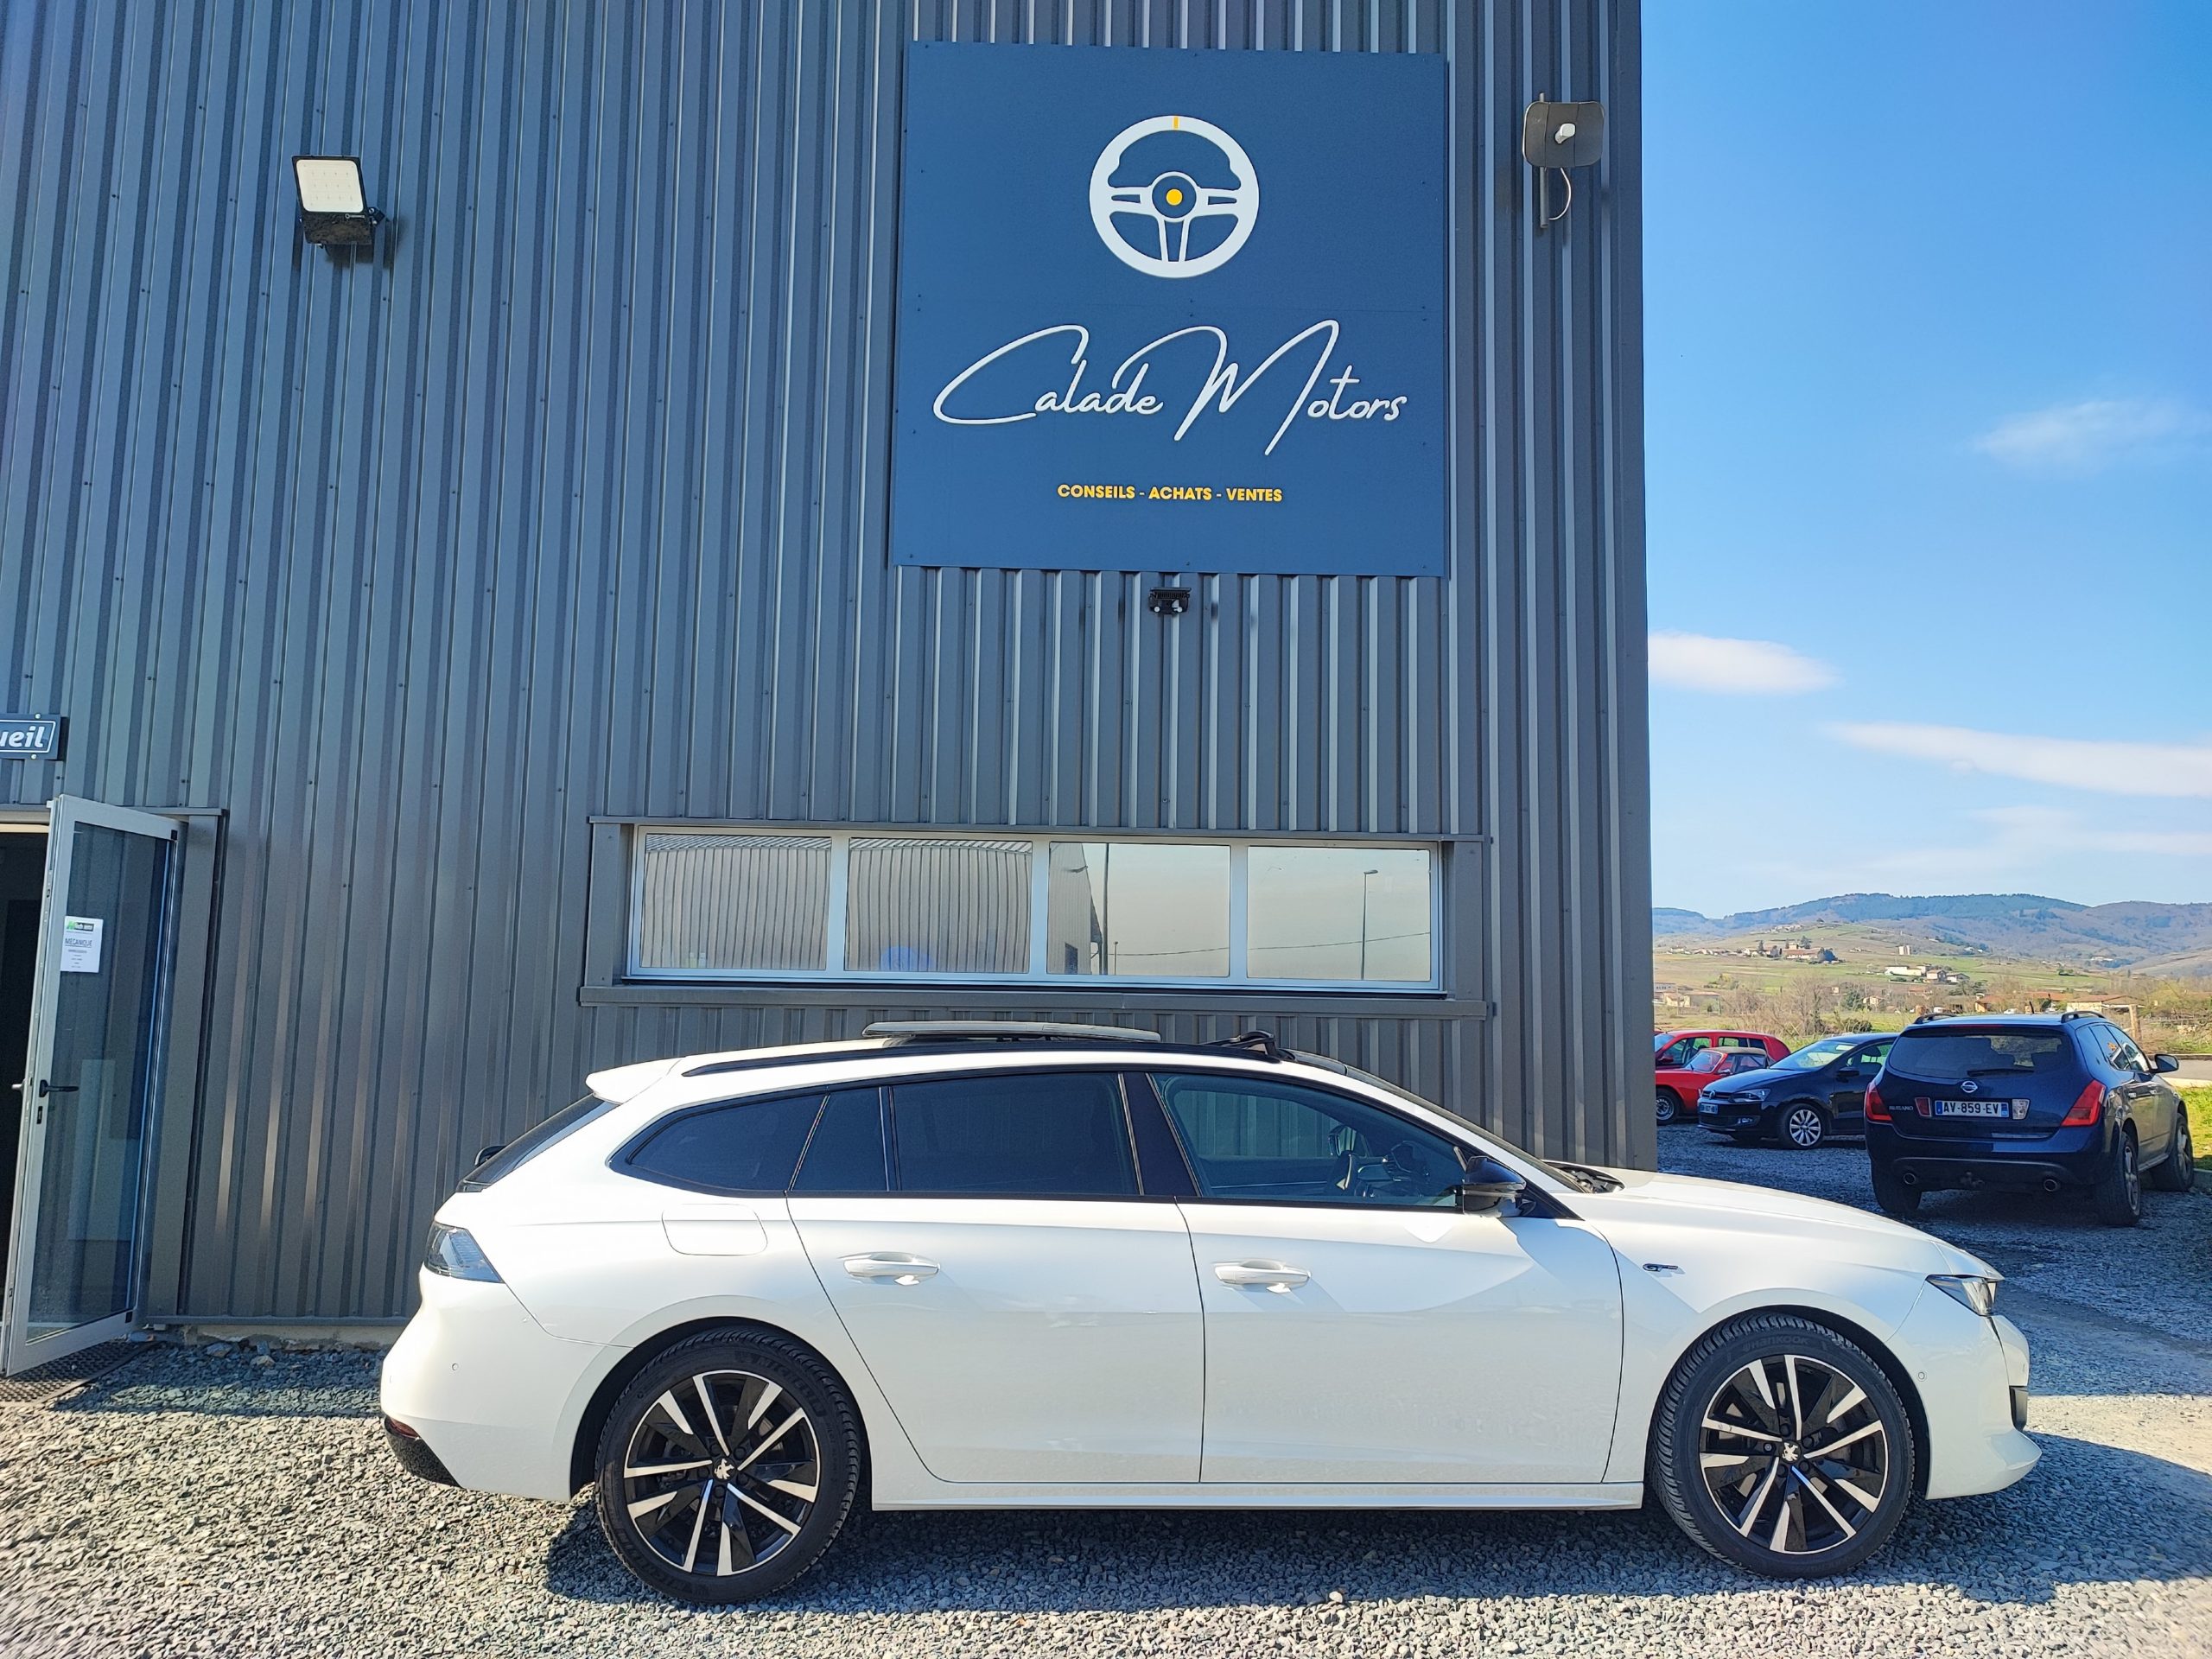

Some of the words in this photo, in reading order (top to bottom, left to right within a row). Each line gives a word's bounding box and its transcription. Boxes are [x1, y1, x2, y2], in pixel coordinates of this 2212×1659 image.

[933, 324, 1164, 424] Calade
[1112, 319, 1408, 456] Motors
[1057, 484, 1135, 499] CONSEILS
[1148, 486, 1212, 500] ACHATS
[1225, 488, 1283, 502] VENTES
[1943, 1102, 1999, 1115] AV-859-EV
